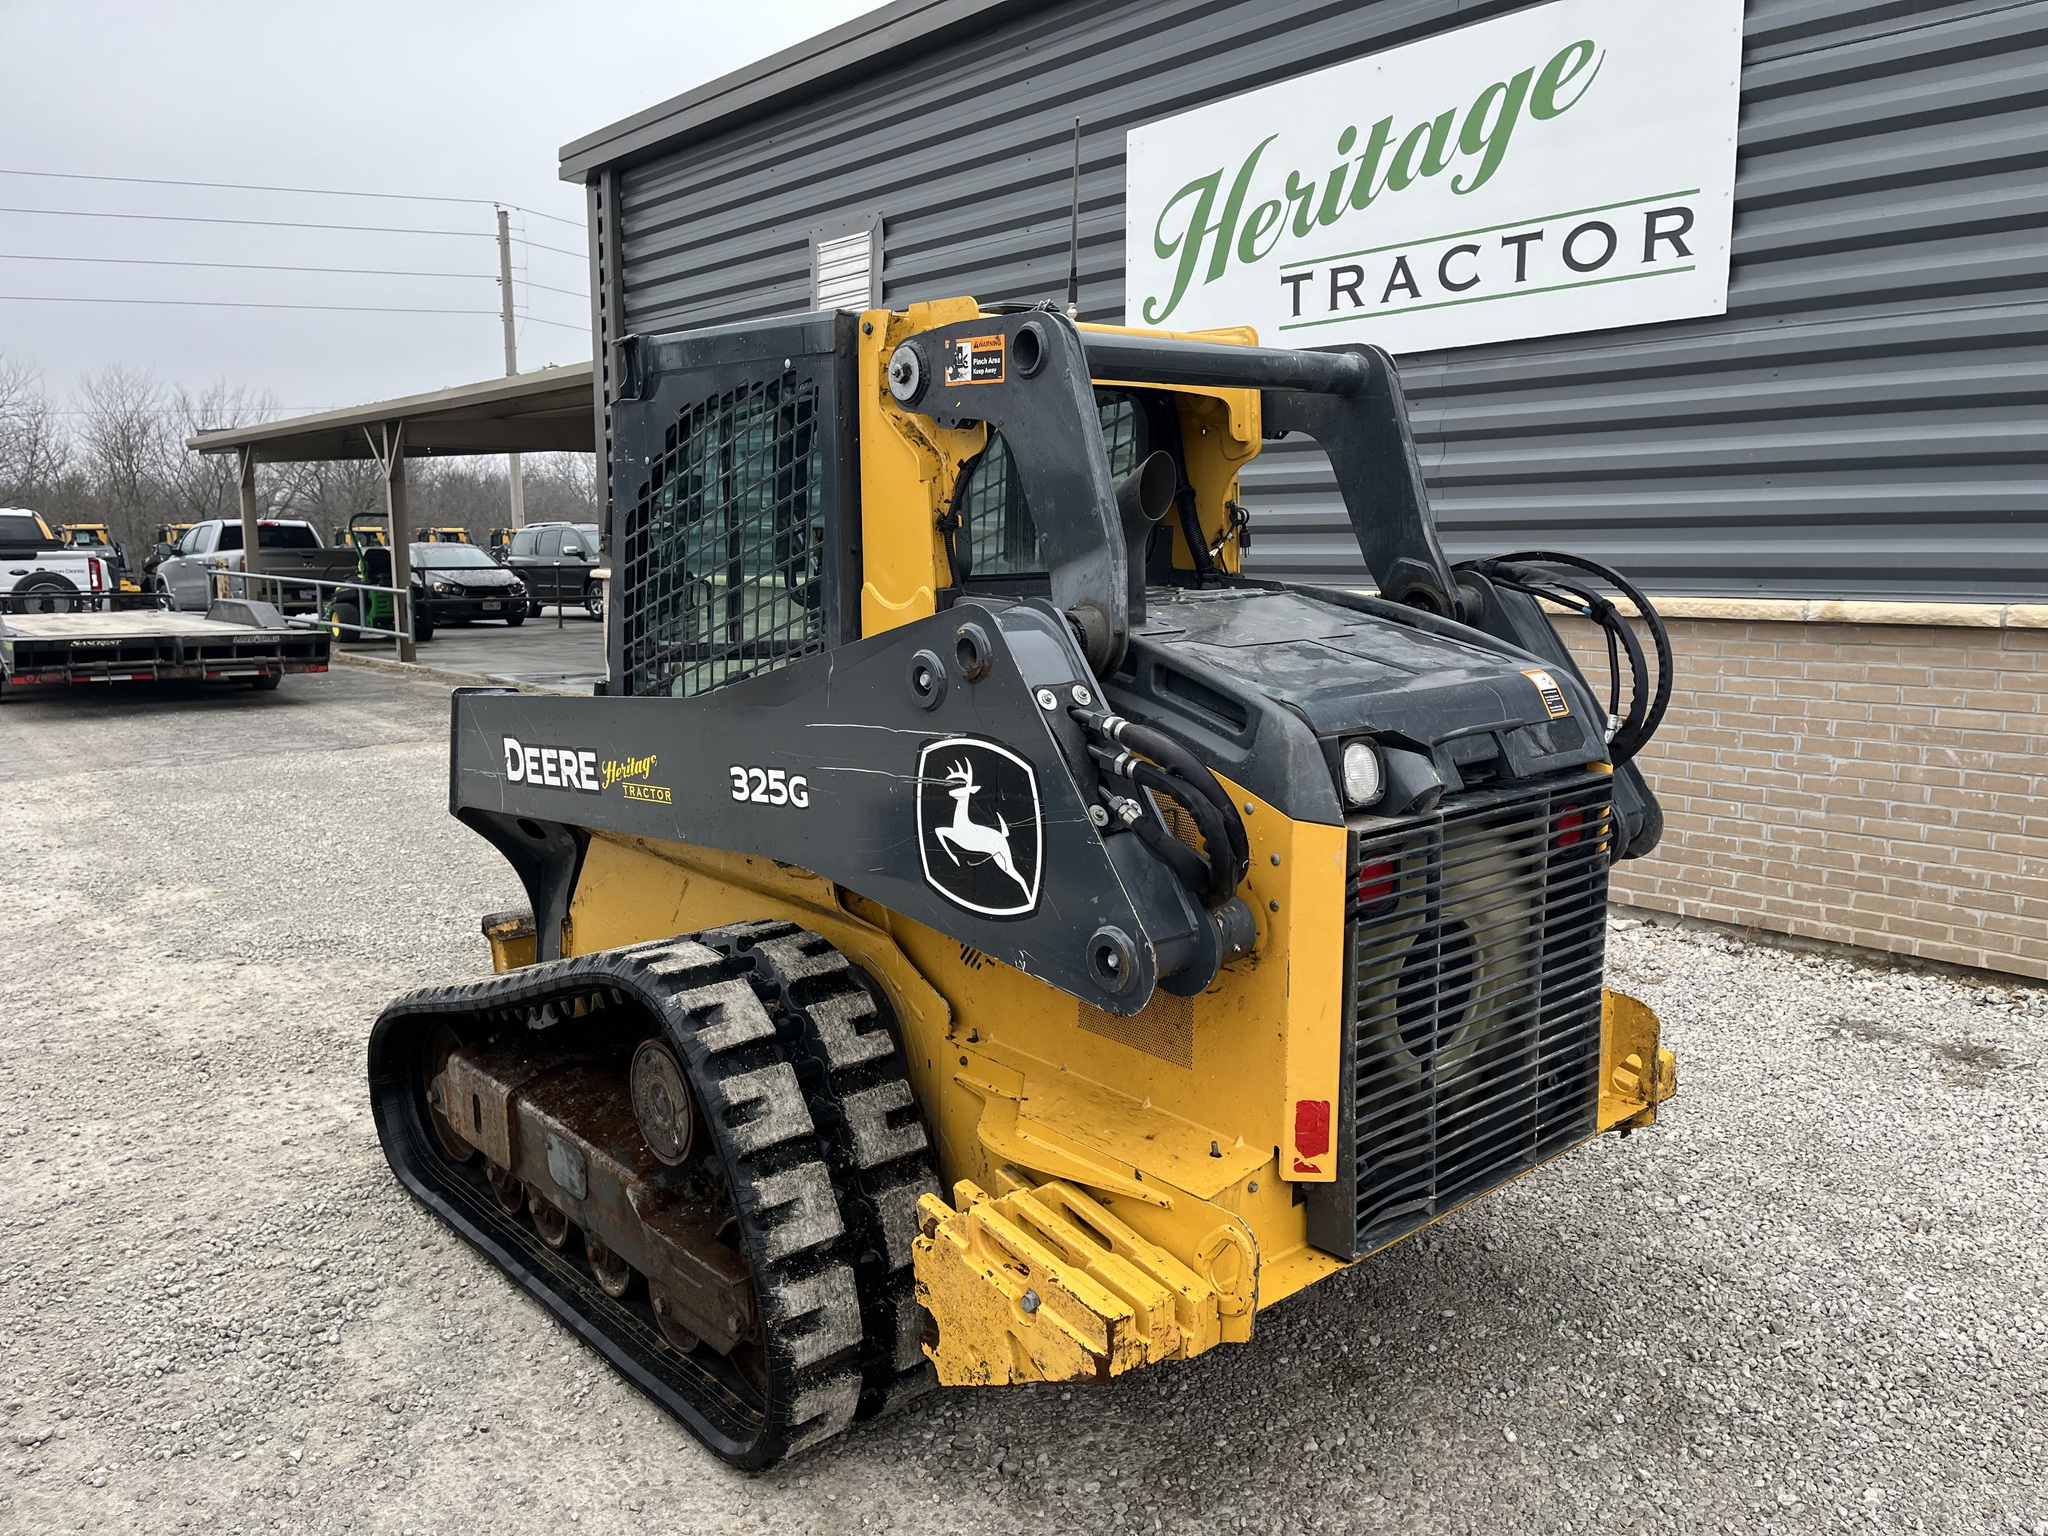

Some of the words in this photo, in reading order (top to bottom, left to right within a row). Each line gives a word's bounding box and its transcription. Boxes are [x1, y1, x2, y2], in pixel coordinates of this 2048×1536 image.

[1143, 39, 1605, 325] Heritage
[1280, 207, 1695, 317] TRACTOR
[973, 357, 987, 365] Pinch
[978, 340, 1001, 348] WARNING
[503, 737, 599, 791] DEERE
[622, 785, 672, 802] TRACTOR
[730, 766, 809, 809] 325G
